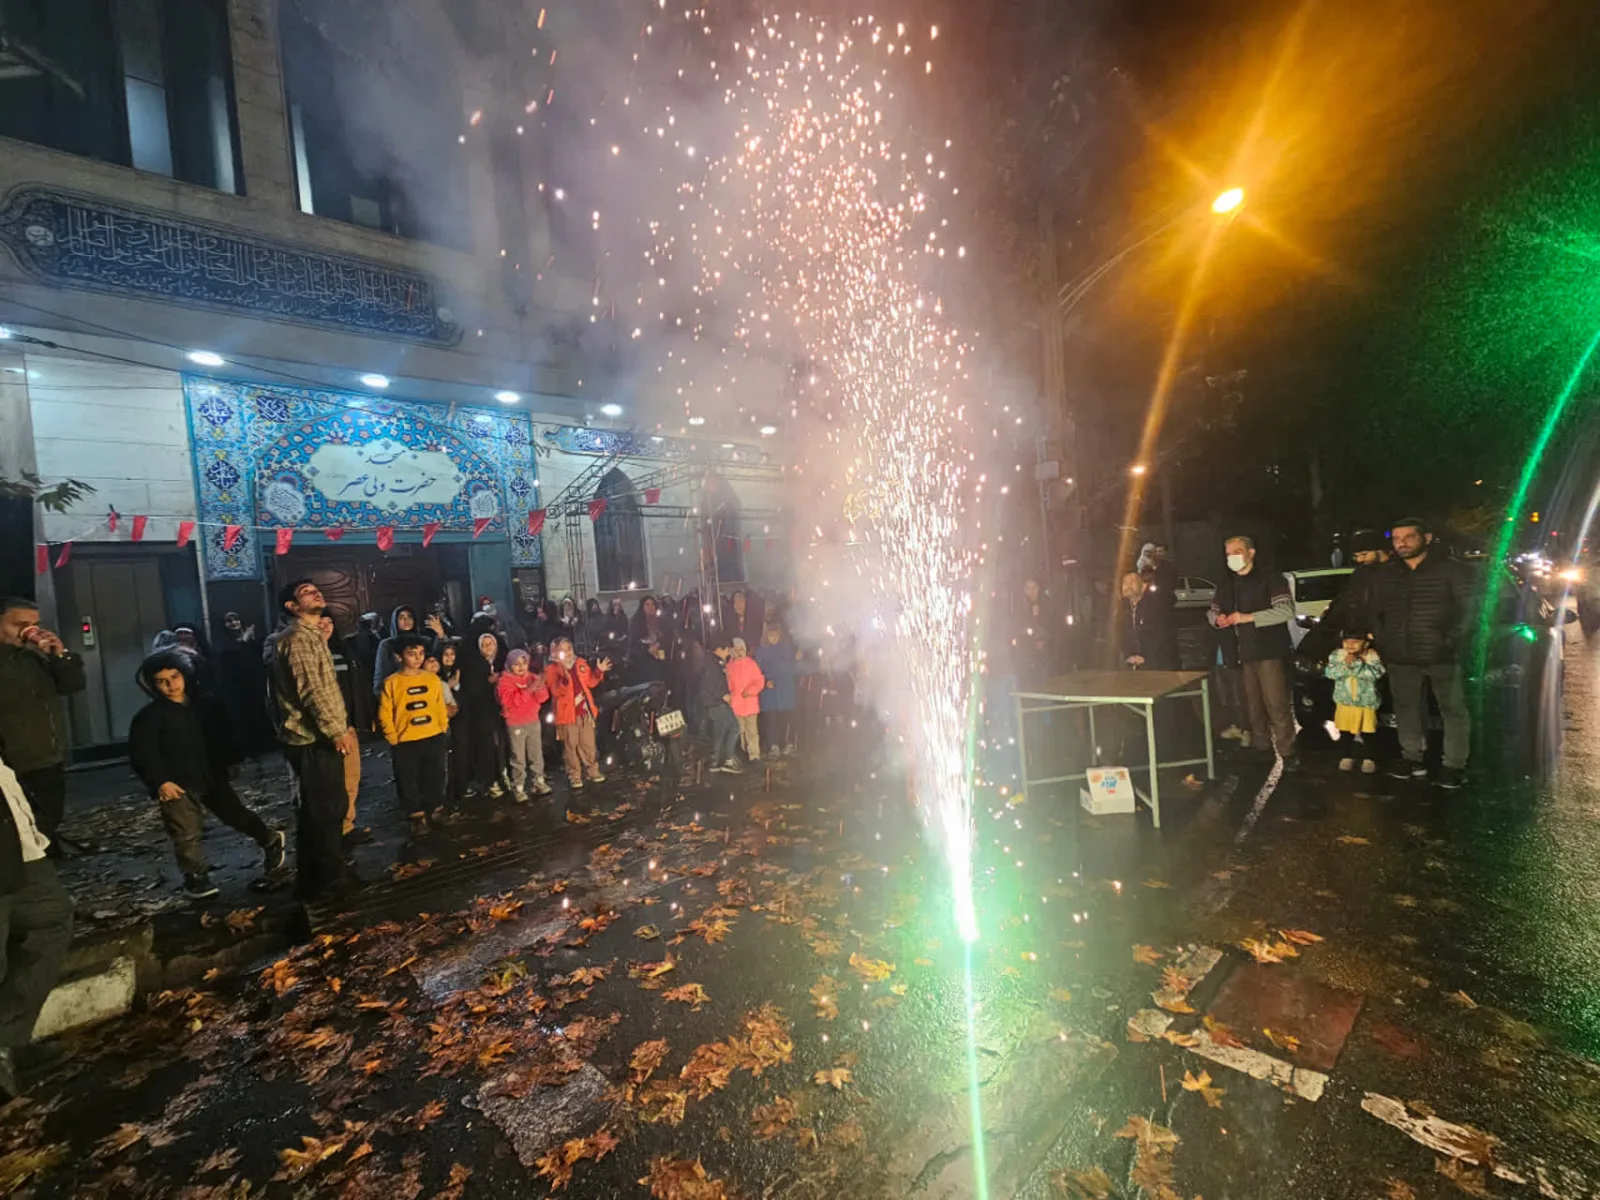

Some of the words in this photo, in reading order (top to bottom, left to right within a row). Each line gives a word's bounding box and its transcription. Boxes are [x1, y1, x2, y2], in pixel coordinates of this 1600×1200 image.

[365, 450, 405, 468] مسجد
[338, 474, 369, 496] عصر
[364, 476, 386, 497] ولی
[390, 472, 437, 496] حضرت
